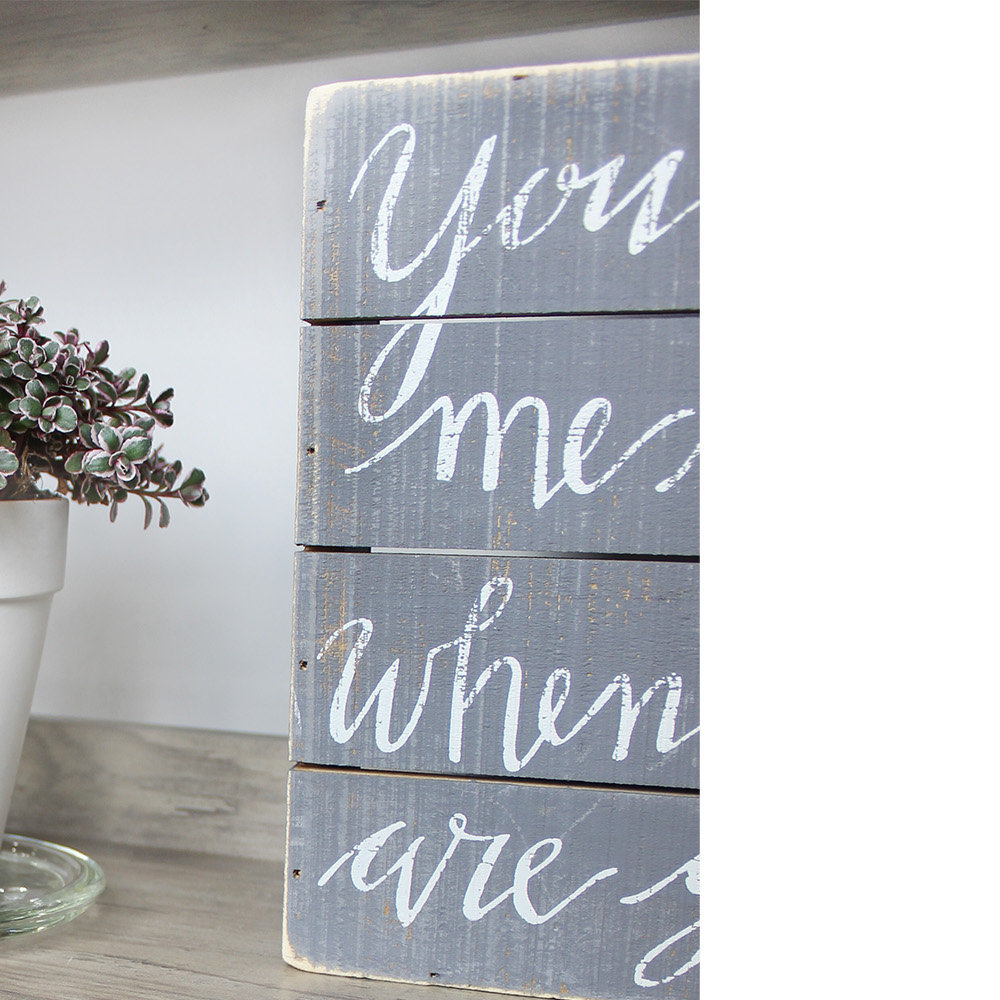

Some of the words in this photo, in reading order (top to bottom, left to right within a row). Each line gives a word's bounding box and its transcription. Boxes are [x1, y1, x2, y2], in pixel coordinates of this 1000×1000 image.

[345, 391, 696, 510] me
[316, 576, 700, 772] when
[317, 812, 618, 928] are
